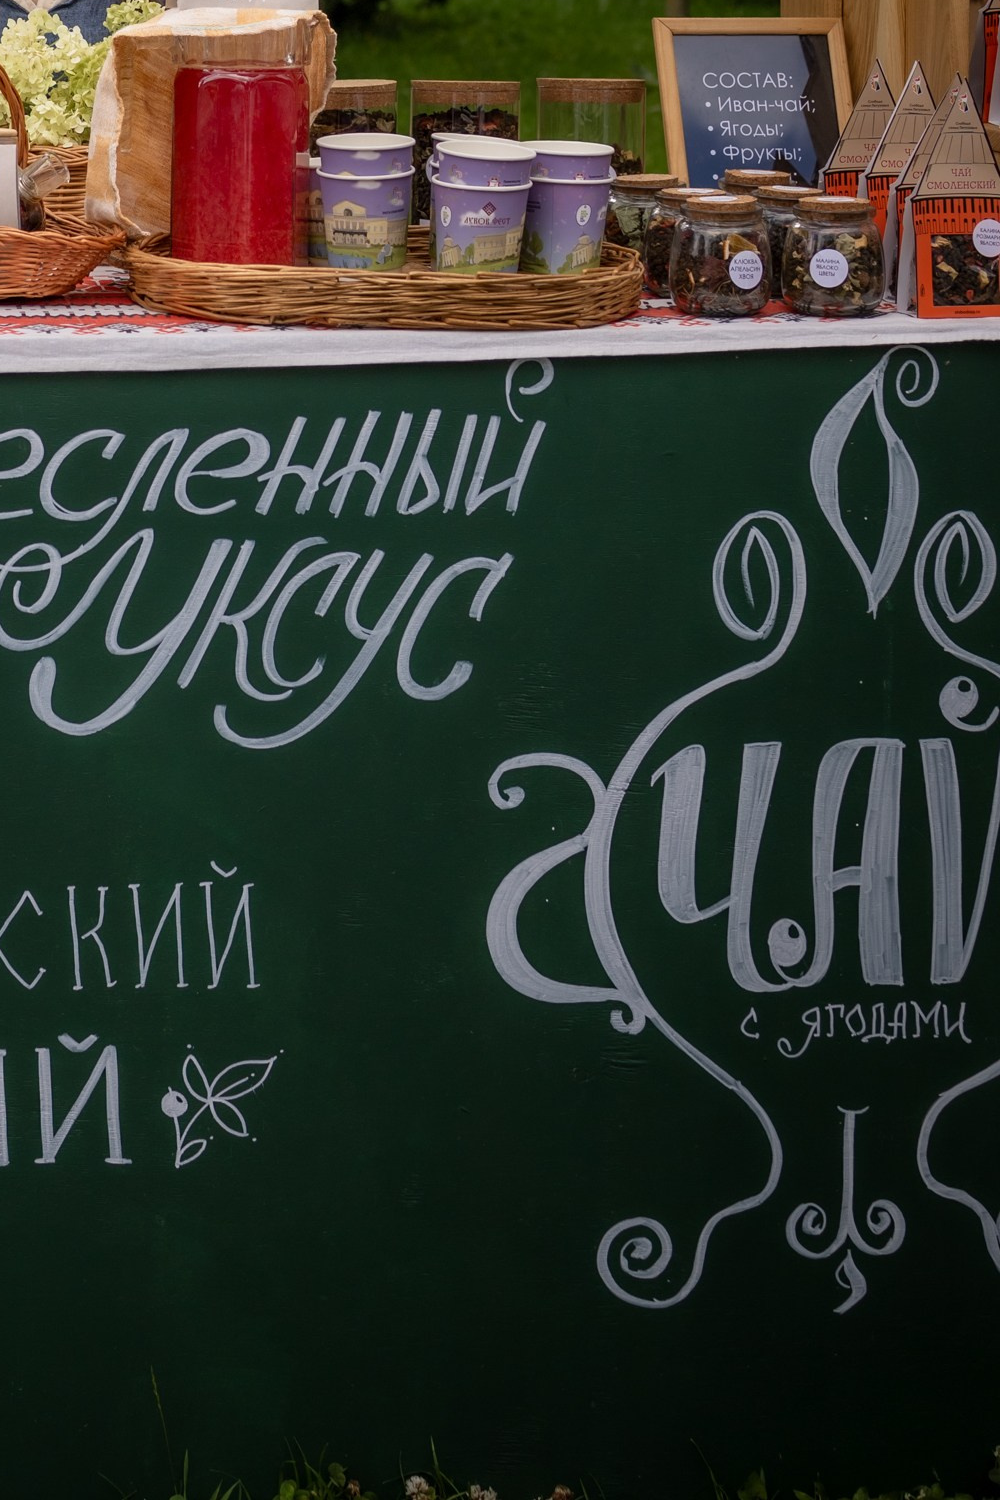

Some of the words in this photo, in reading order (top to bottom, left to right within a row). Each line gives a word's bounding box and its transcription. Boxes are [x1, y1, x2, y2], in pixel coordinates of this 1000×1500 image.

[702, 72, 794, 89] СОСТАВ:
[718, 95, 816, 113] Иван-чай;
[720, 120, 785, 137] Ягоды;
[722, 144, 802, 164] Фрукты;
[951, 168, 972, 177] ЧАЙ
[927, 180, 997, 190] СМОЛЕНСКИЙ
[778, 1001, 972, 1058] ЯГОДАМИ
